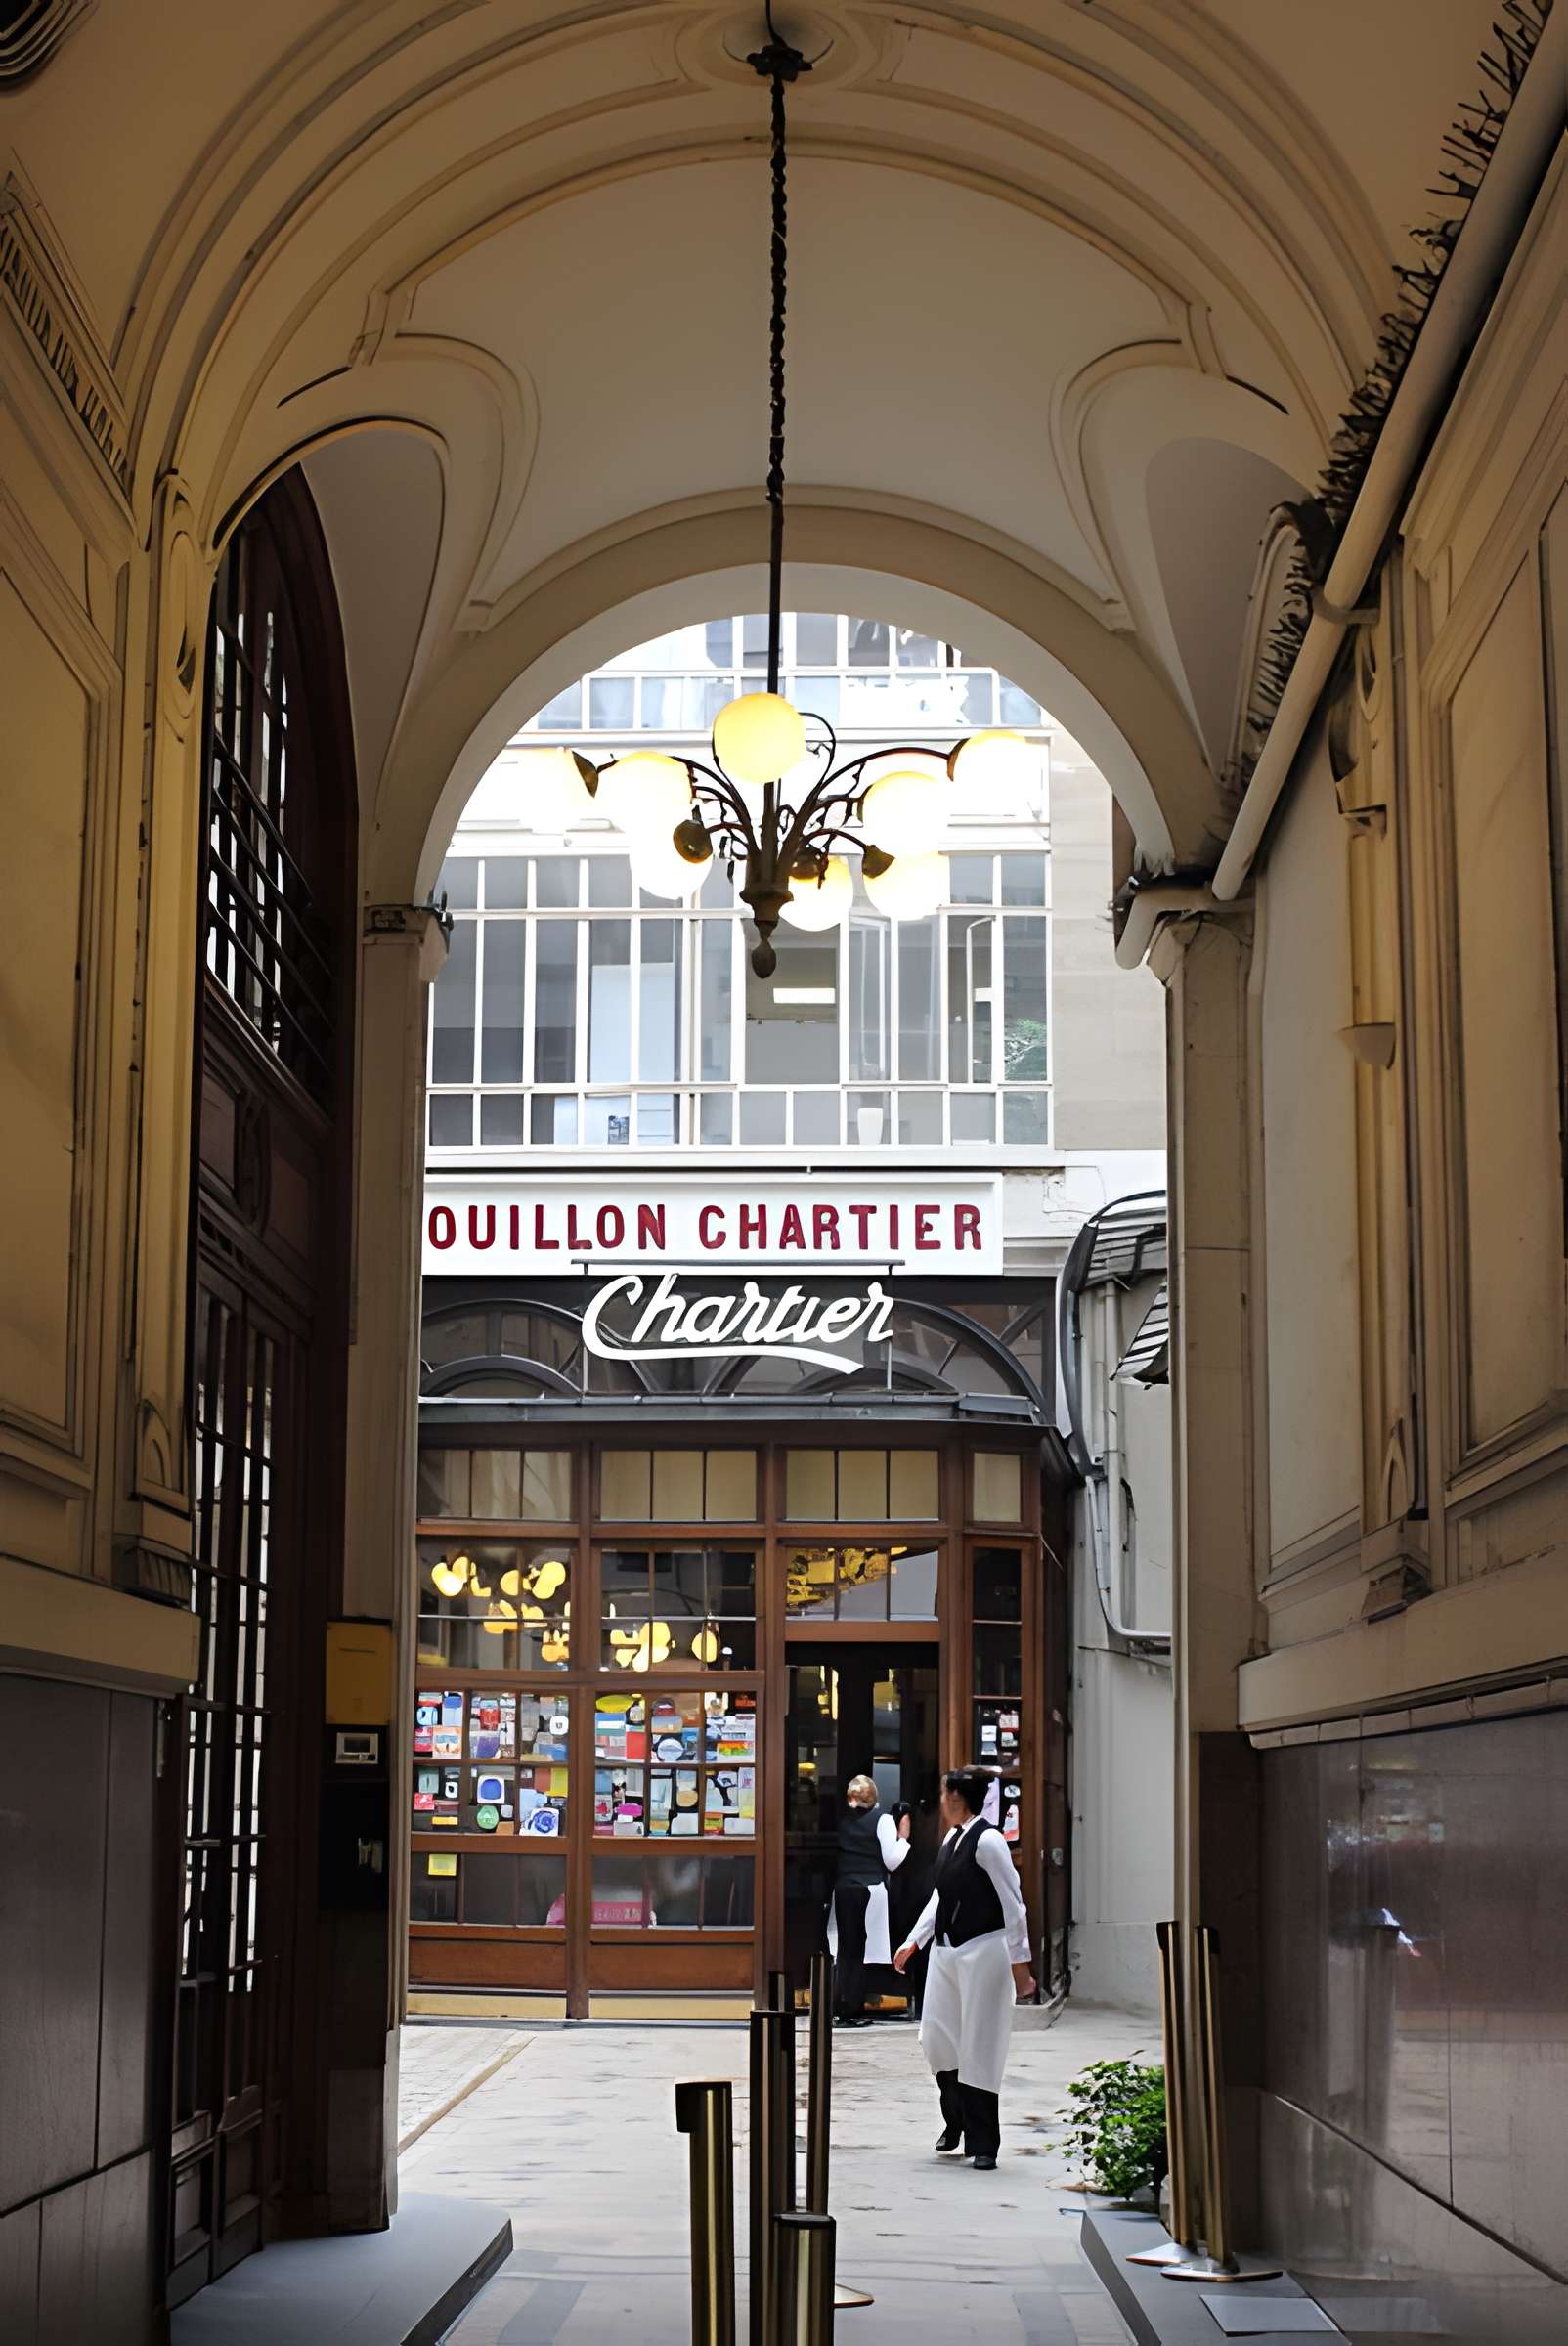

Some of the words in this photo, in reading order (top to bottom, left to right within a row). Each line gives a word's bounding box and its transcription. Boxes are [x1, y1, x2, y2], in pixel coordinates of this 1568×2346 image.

[428, 1204, 666, 1250] OUILLON
[699, 1203, 982, 1250] CHARTIER
[582, 1273, 894, 1374] Chartier
